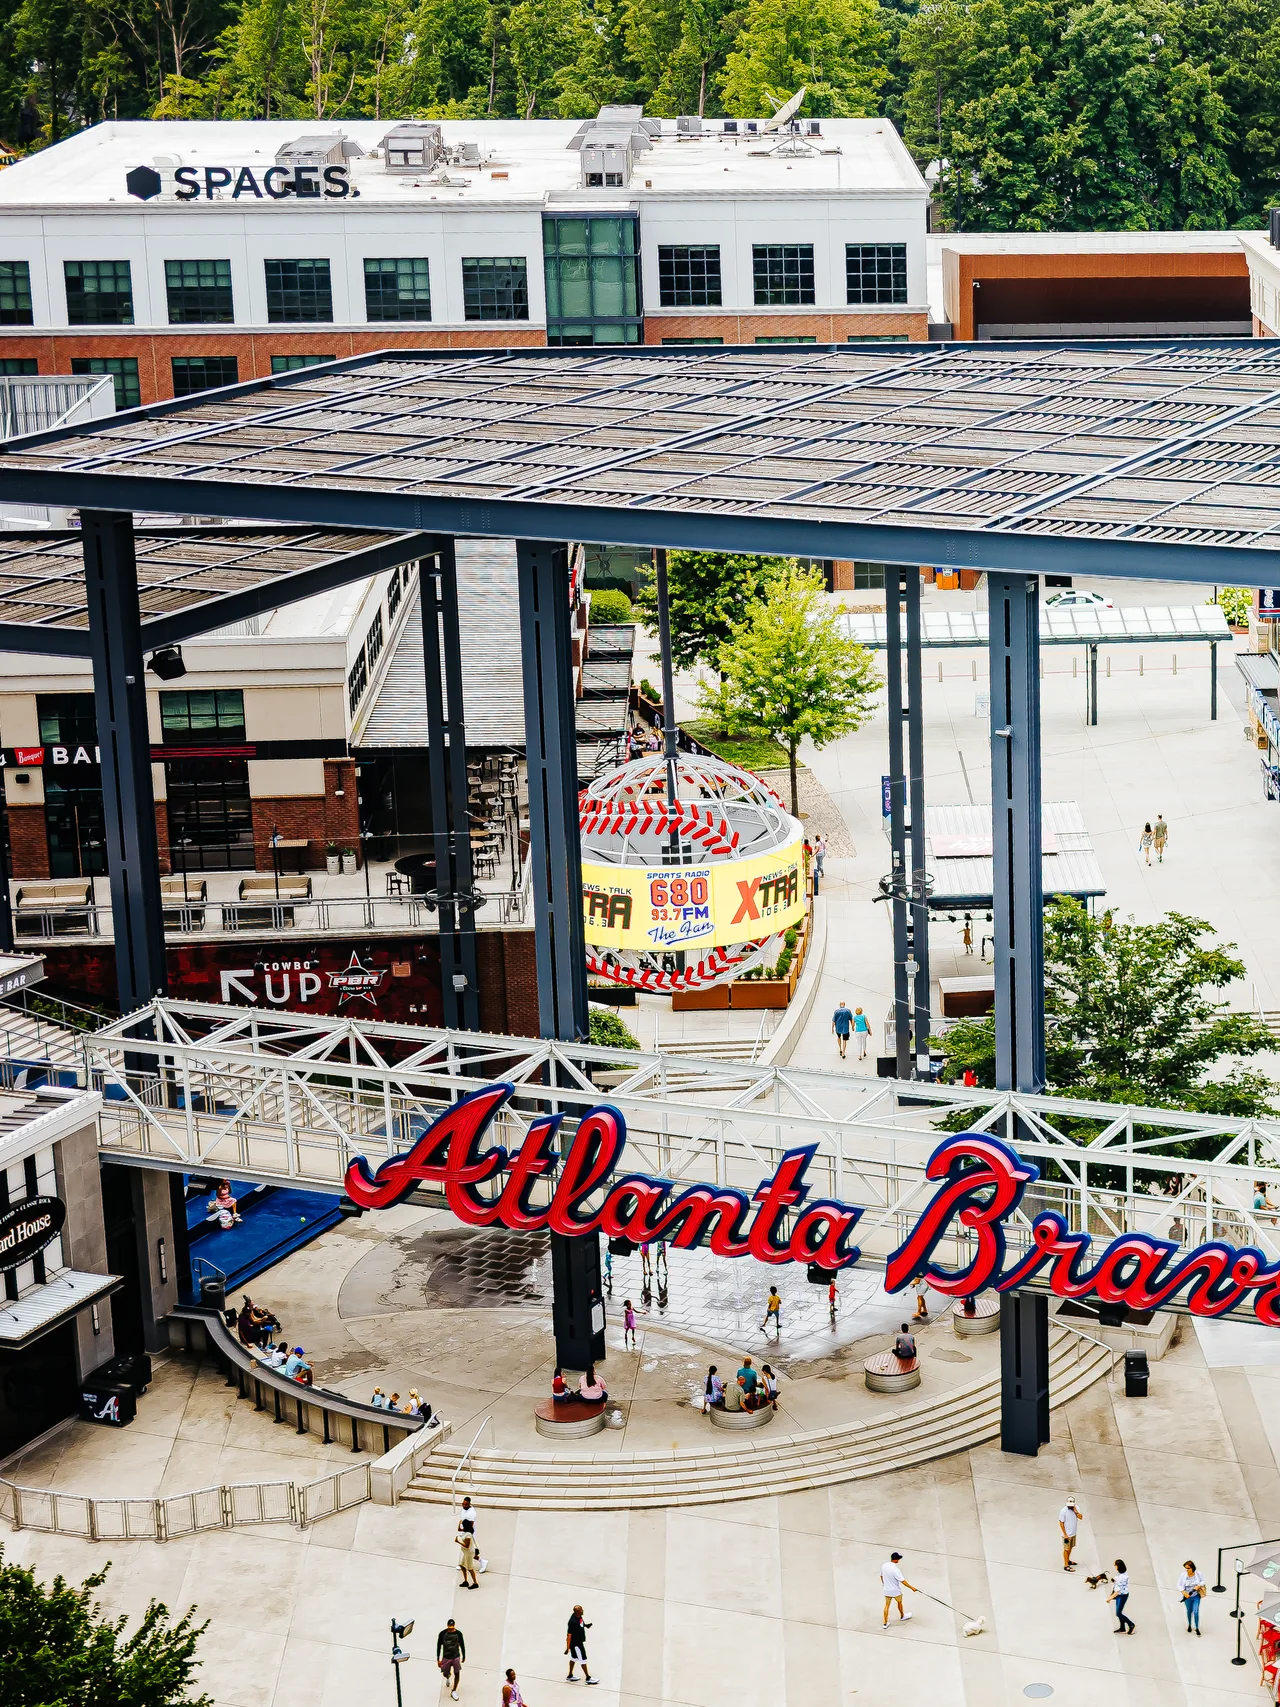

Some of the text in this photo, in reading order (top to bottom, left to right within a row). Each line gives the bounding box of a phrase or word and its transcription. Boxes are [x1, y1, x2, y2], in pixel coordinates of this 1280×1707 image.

[18, 751, 43, 764] Banquet
[52, 746, 100, 765] BA
[647, 870, 710, 880] SPORTS RADIO
[763, 869, 783, 882] NEWS
[609, 886, 632, 896] TALK
[650, 877, 709, 907] 680
[730, 868, 798, 925] XTRA
[761, 901, 788, 918] 106.3
[648, 920, 715, 943] The Fan
[263, 960, 312, 972] COWBO
[6, 974, 26, 992] BAR
[264, 972, 322, 1004] UP
[332, 976, 379, 986] PBR
[344, 1082, 868, 1270] Atlanta
[16, 1213, 52, 1244] House
